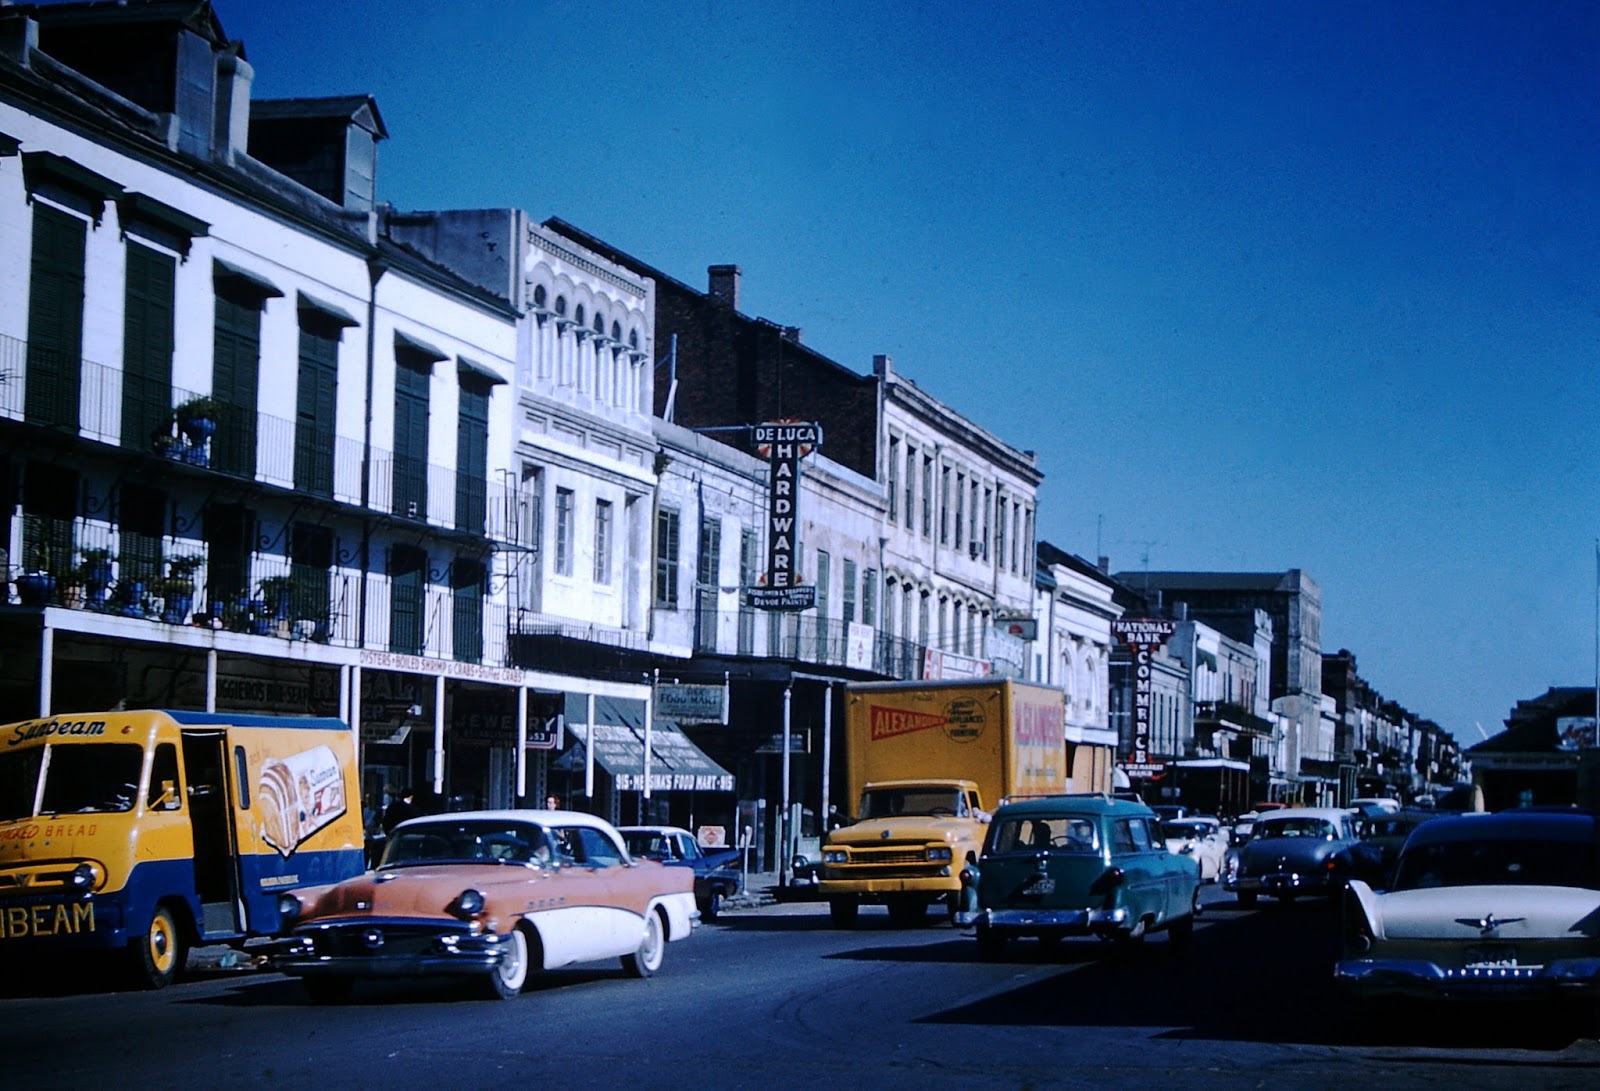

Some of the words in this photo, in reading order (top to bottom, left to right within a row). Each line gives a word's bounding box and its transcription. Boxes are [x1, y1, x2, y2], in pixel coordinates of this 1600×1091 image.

[756, 428, 774, 441] DE
[777, 428, 816, 441] LUCA
[773, 444, 793, 587] HARDWARE
[781, 597, 808, 606] PAINTS
[1117, 622, 1172, 634] NATIONAL
[1127, 632, 1161, 643] BANK
[360, 651, 391, 667] OYSTERS
[396, 655, 420, 670] BOILED
[455, 662, 475, 678] CRABS
[502, 669, 522, 684] CRABS
[660, 693, 687, 705] FOOD
[1136, 652, 1149, 763] COMMERCE
[8, 720, 107, 746] Sunbeam
[616, 774, 630, 791] 915
[633, 774, 672, 791] MESINA'S
[673, 774, 695, 791] FOOD
[696, 775, 717, 791] MART
[720, 775, 733, 791] 915
[46, 825, 98, 838] BREAD
